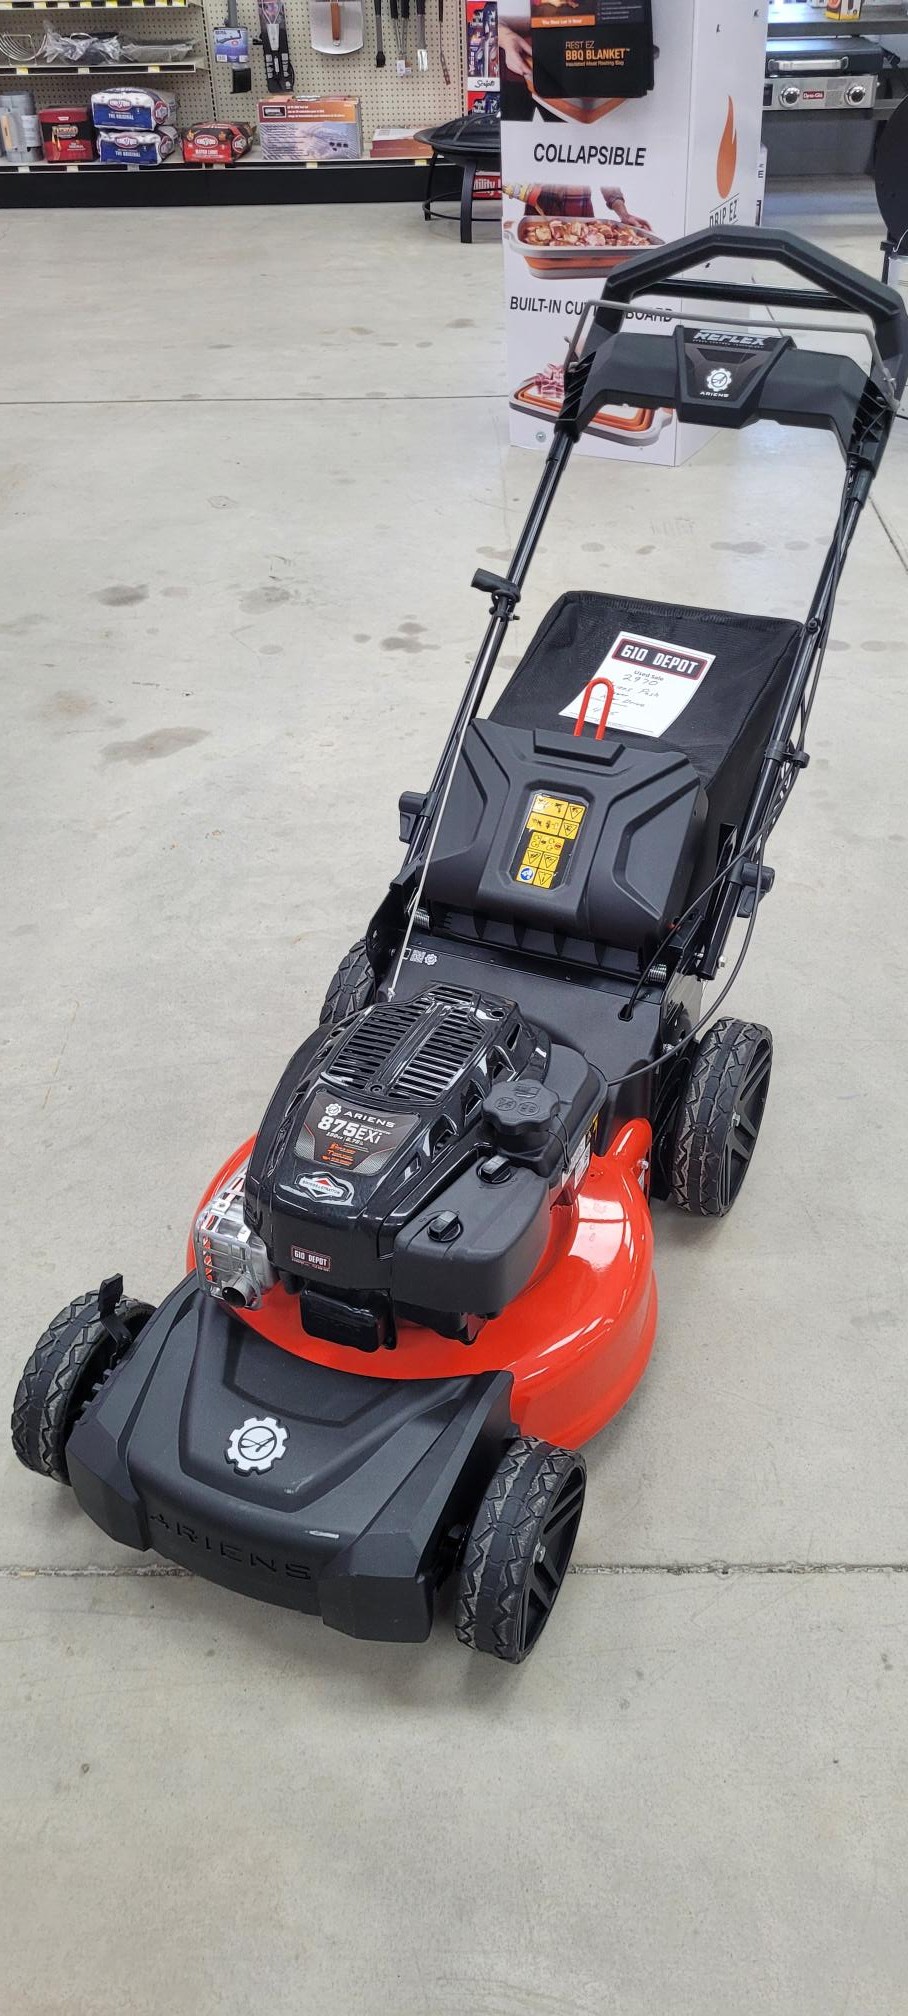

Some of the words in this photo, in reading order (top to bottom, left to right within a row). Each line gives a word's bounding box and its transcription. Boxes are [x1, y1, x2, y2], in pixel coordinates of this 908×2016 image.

[565, 50, 584, 60] BBQ
[533, 143, 647, 166] COLLAPSIBLE
[728, 199, 738, 222] EZ
[510, 296, 562, 314] BUILT-IN
[692, 332, 765, 346] REFLEX
[620, 644, 649, 662] 610
[652, 653, 699, 674] DEPOT
[343, 1111, 396, 1128] ARIENS
[308, 1254, 328, 1266] DEPOT
[149, 1513, 312, 1581] ARIENS
